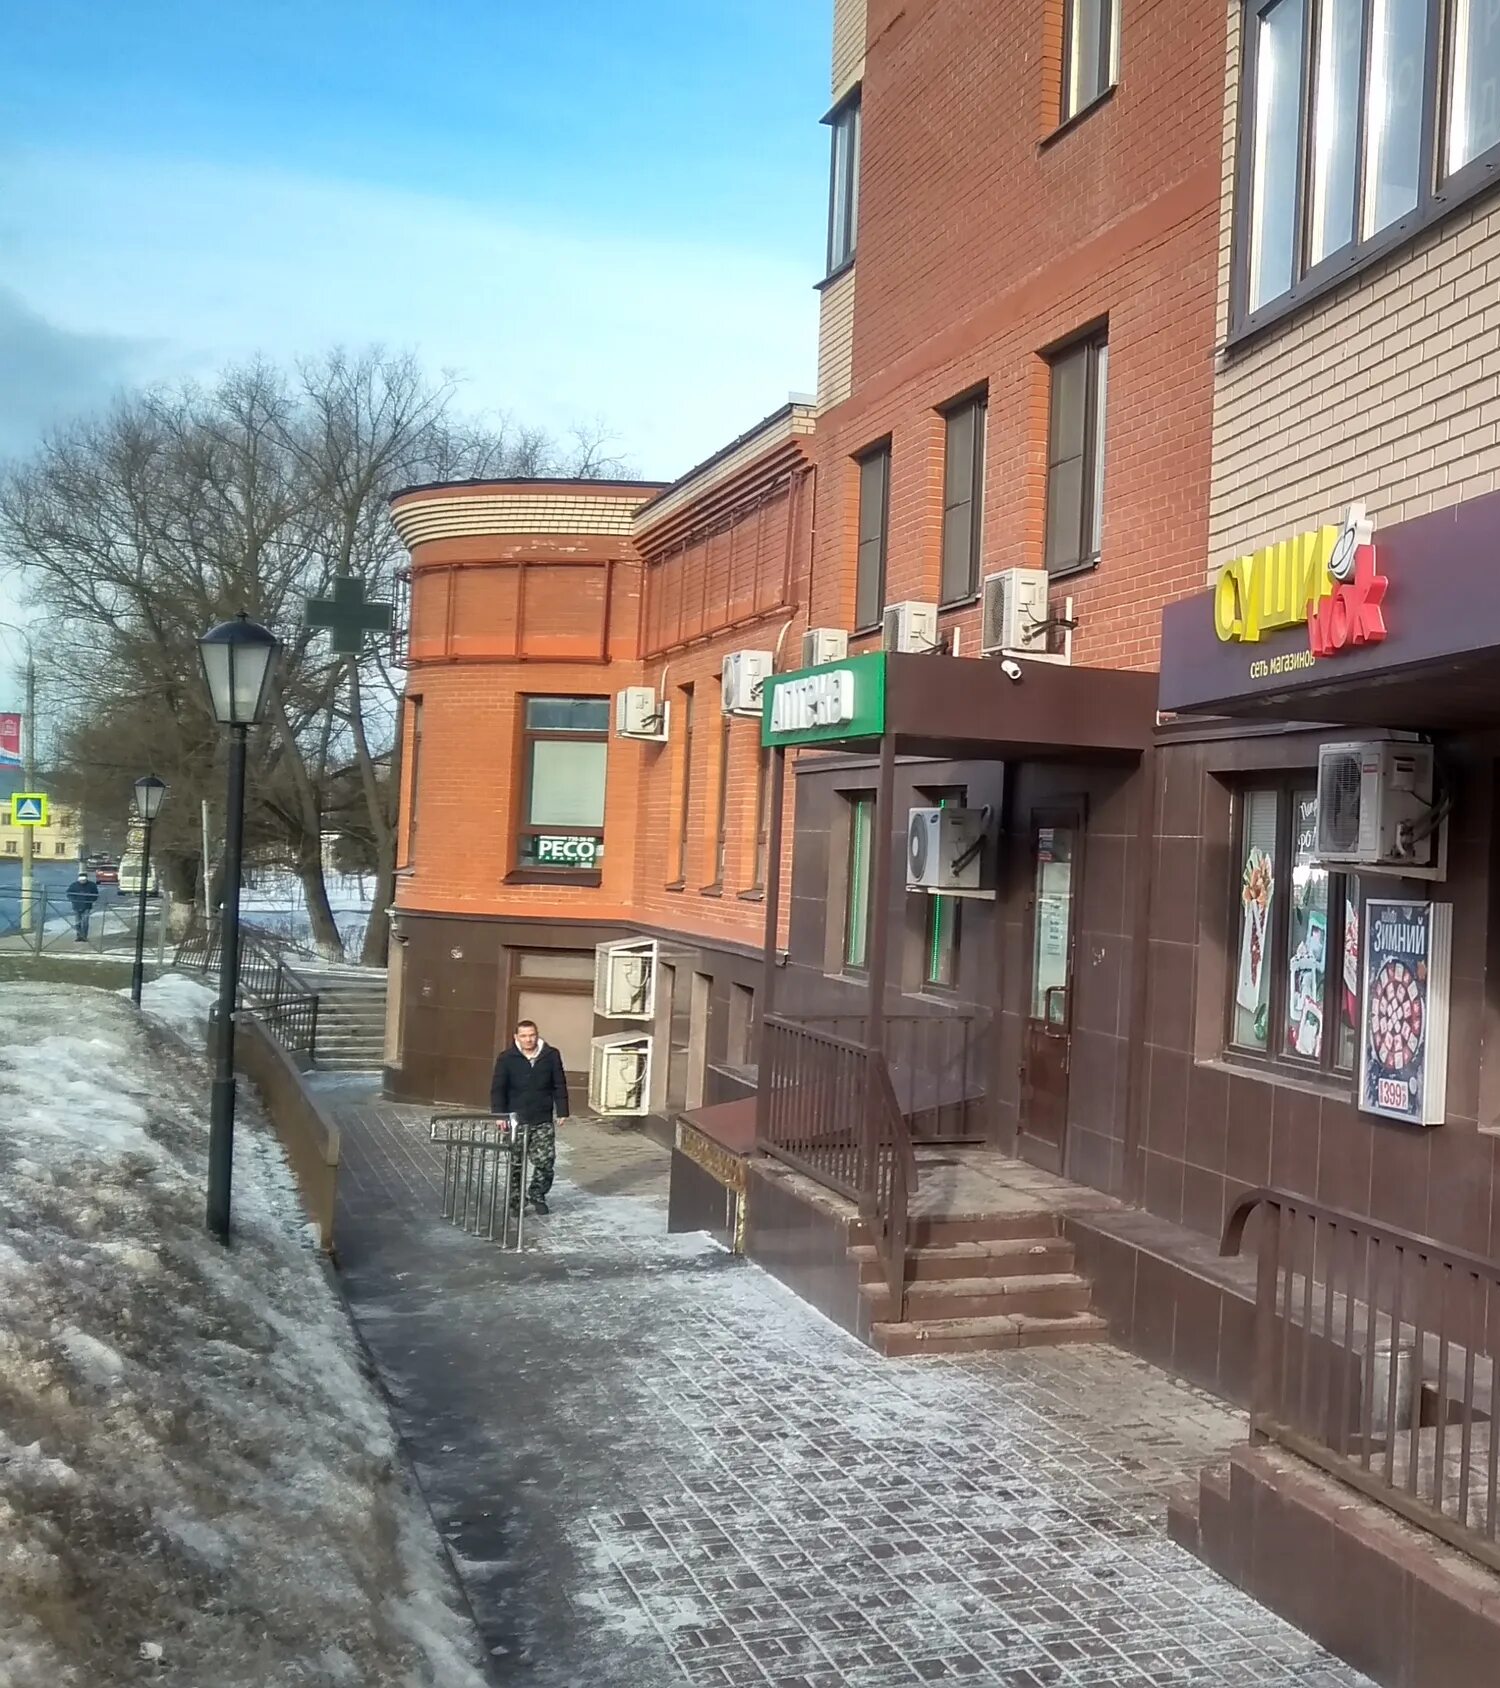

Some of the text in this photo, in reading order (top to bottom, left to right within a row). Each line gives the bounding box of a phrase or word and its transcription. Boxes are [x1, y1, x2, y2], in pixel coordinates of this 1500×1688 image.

[1250, 659, 1269, 679] сеть
[538, 840, 595, 858] РЕСО
[1374, 916, 1425, 955] ЗИМНИЙ
[1384, 1081, 1401, 1106] 399
